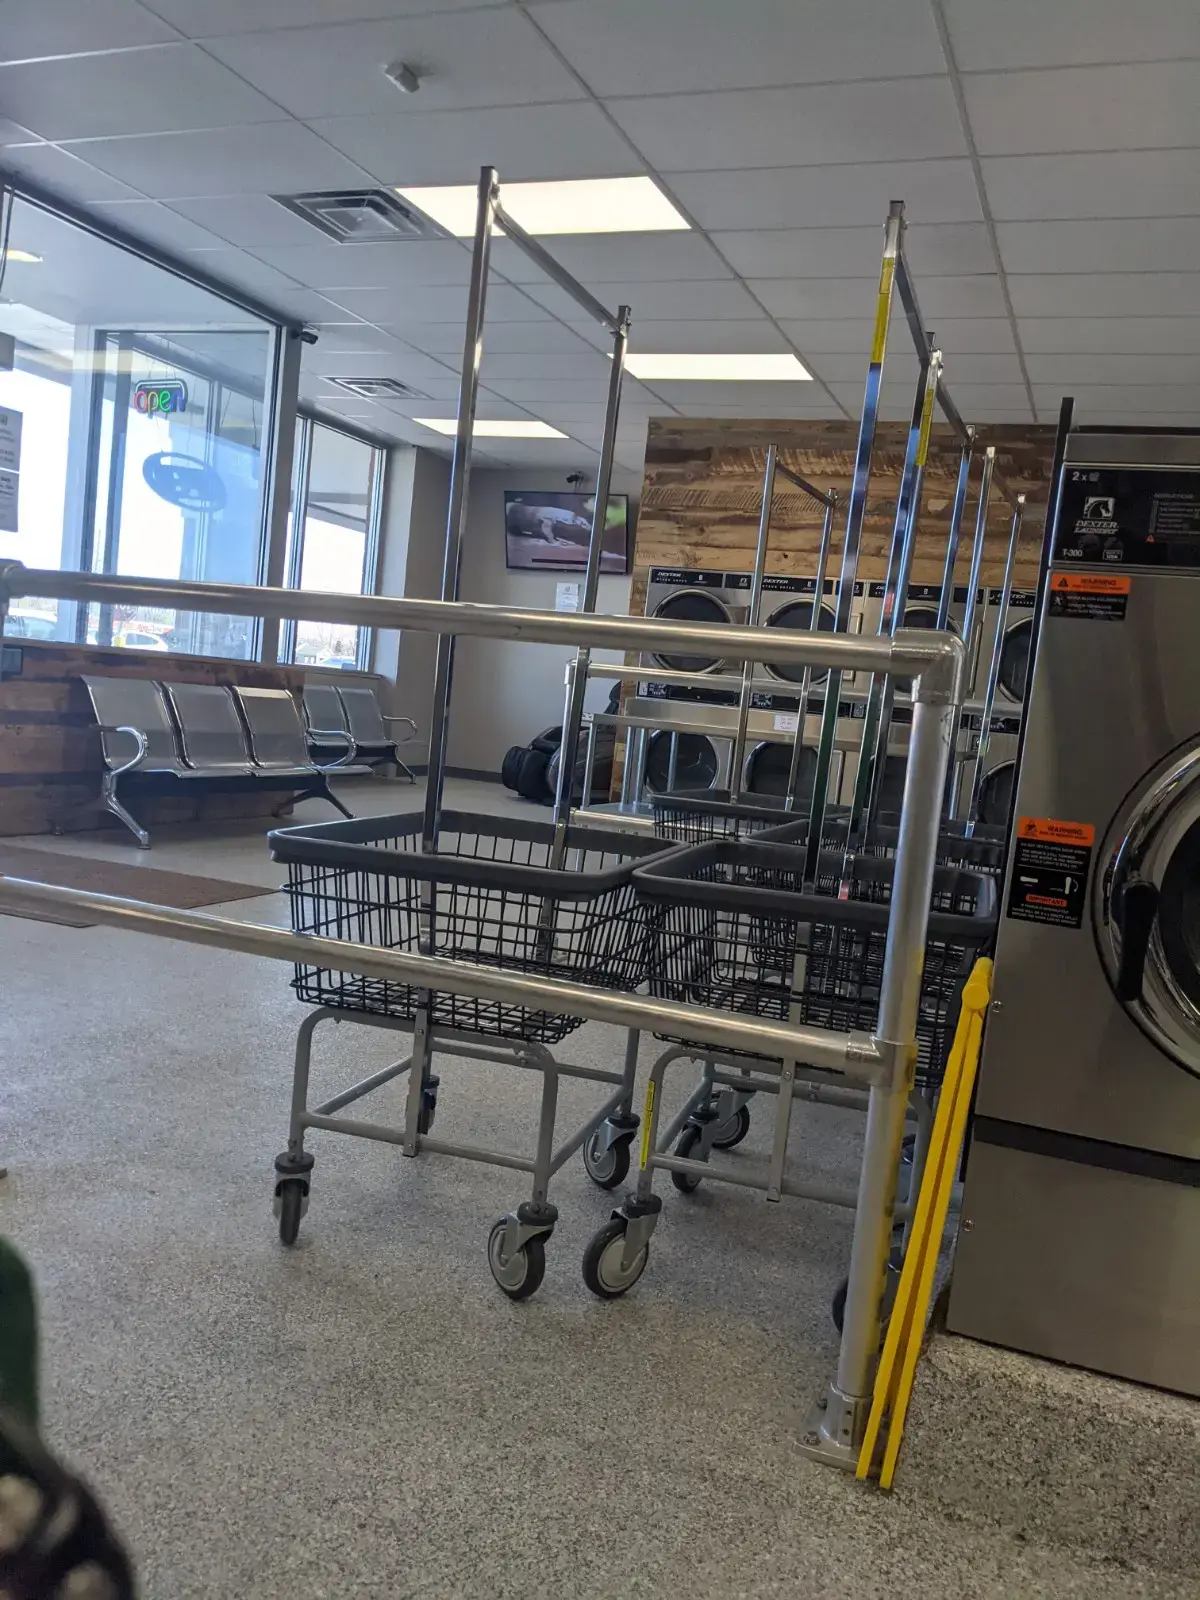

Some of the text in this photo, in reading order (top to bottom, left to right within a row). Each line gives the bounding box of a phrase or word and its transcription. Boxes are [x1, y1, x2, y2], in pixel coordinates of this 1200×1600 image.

[134, 390, 185, 418] open
[1072, 471, 1080, 481] 2
[1075, 520, 1118, 528] DEXTER
[1073, 527, 1118, 535] LAUNDRY
[1062, 548, 1083, 557] T-300
[1028, 895, 1065, 906] IMPORTANT
